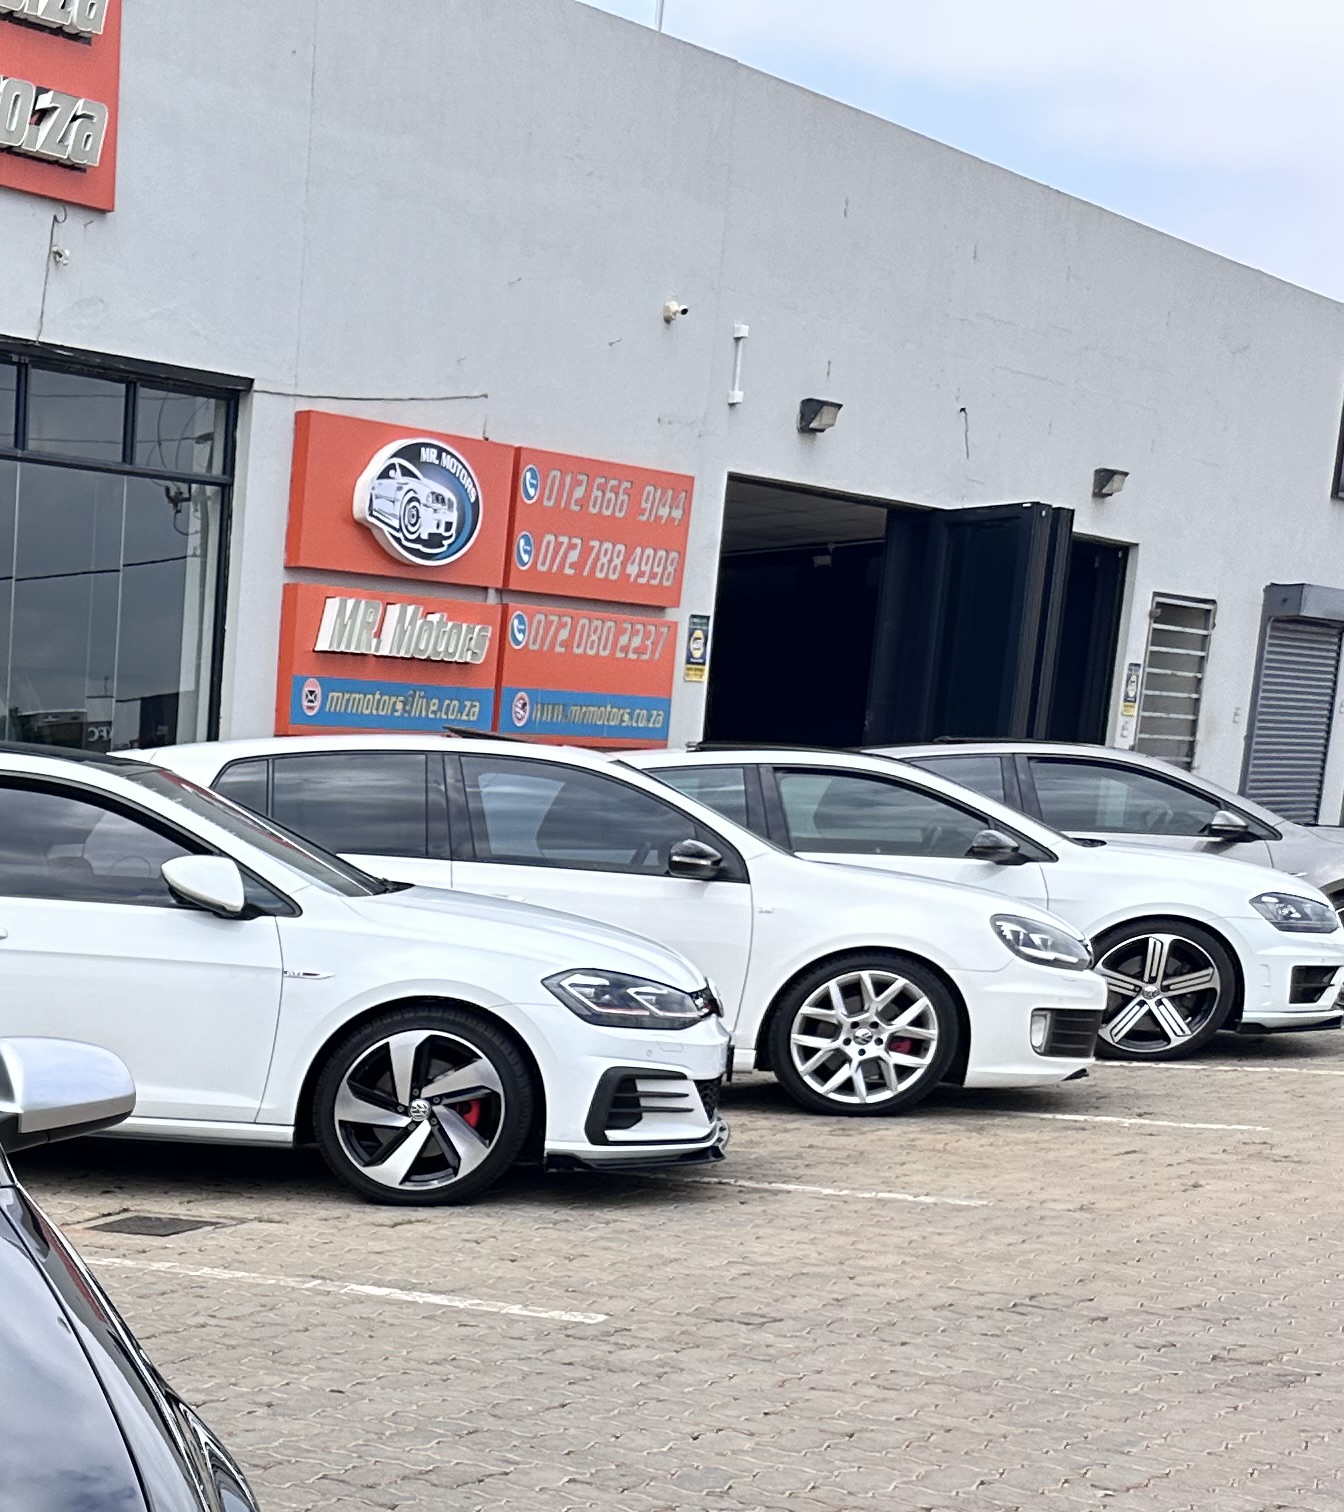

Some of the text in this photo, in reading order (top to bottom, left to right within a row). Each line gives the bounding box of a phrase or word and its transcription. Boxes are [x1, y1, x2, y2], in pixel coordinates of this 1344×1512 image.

[419, 447, 477, 503] MR. MOTORS
[543, 468, 687, 526] 012 666 9144
[537, 533, 681, 587] 072 788 4998
[314, 597, 492, 664] MR. Motors
[528, 613, 572, 653] 072
[573, 617, 616, 657] 080
[615, 621, 670, 661] 2237
